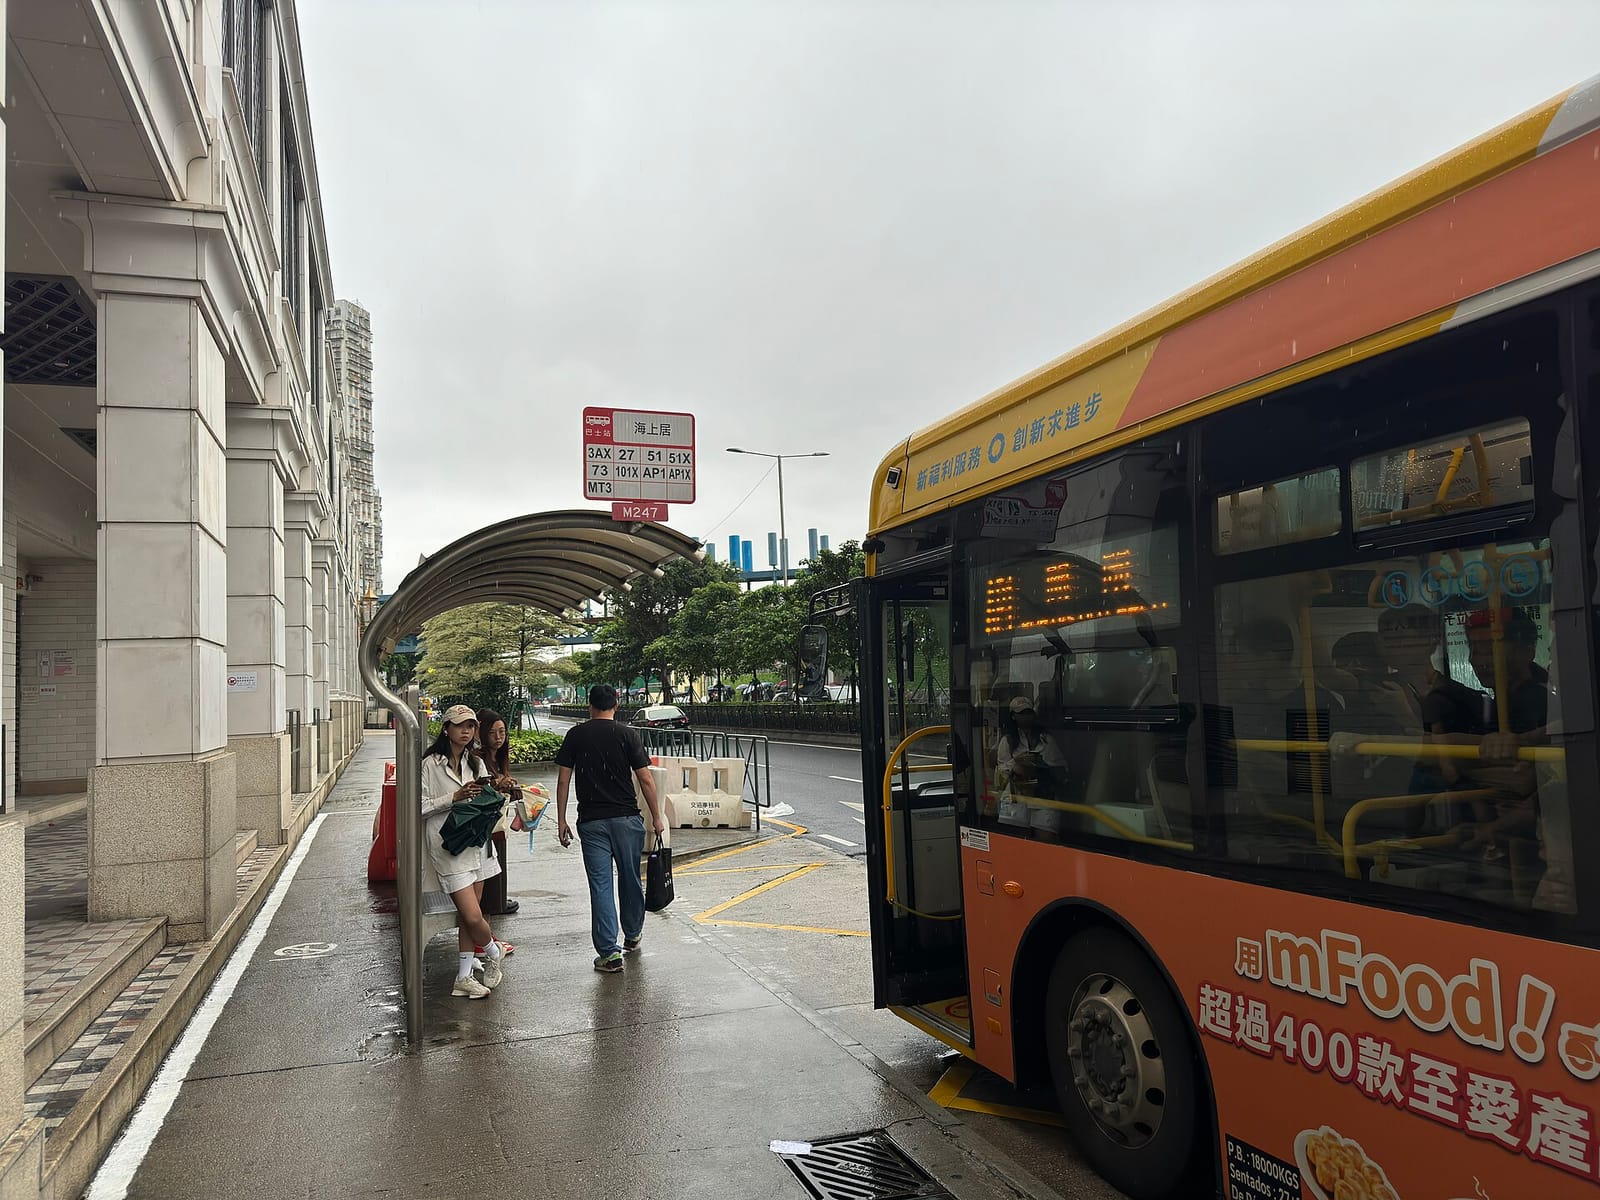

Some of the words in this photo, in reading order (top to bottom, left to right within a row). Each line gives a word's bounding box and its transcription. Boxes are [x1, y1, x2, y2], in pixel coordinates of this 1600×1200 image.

[585, 428, 611, 438] 巴士站
[634, 421, 671, 437] 海上居
[916, 445, 982, 491] 新福利服務
[1012, 392, 1103, 453] 創新求進步
[588, 447, 612, 460] 3AX
[618, 449, 635, 461] 27
[647, 450, 662, 462] 51
[668, 452, 691, 465] 51X
[591, 464, 609, 477] 73
[615, 465, 639, 478] 101X
[642, 467, 666, 479] AP1
[668, 468, 691, 481] AP1X
[588, 481, 612, 494] MT3
[623, 506, 658, 518] M247
[1235, 936, 1262, 980] 用
[1199, 983, 1600, 1178] 超過400款至愛產
[1229, 1162, 1272, 1198] Sentados
